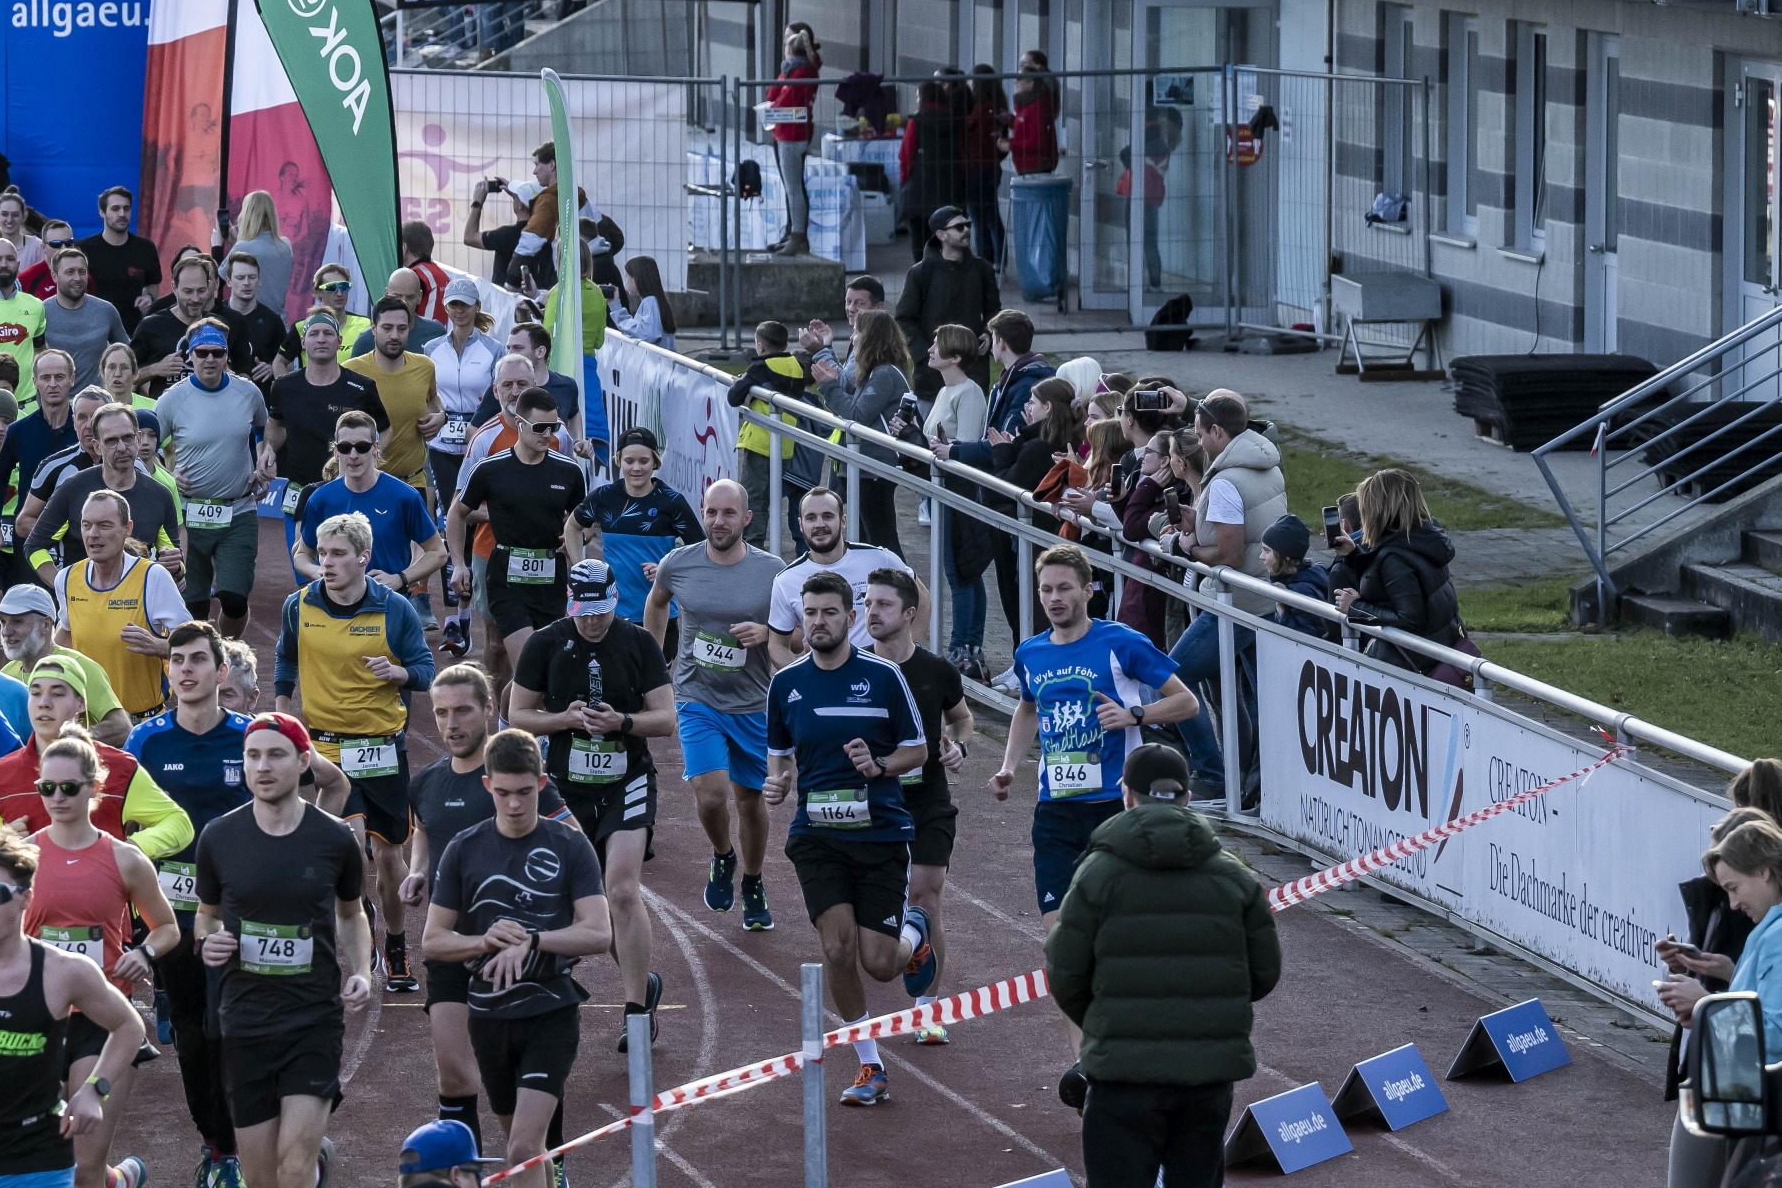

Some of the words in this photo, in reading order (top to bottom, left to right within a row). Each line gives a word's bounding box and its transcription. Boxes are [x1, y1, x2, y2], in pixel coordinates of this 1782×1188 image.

[198, 506, 222, 518] 409
[521, 559, 544, 572] 801
[108, 598, 138, 607] DACHSER
[349, 625, 380, 633] DACHSER
[706, 643, 733, 661] 944
[1033, 672, 1054, 685] Wyk
[1056, 667, 1074, 676] auf
[1074, 666, 1098, 680] Föhr
[851, 682, 868, 691] wfv
[1298, 660, 1428, 820] CREATON
[357, 747, 381, 764] 271
[584, 753, 612, 769] 102
[163, 763, 184, 771] JAKO
[1054, 765, 1087, 782] 846
[820, 806, 856, 820] 1164
[172, 876, 194, 895] 49
[1490, 842, 1508, 897] Die
[1511, 852, 1576, 929] Dachmarke
[1579, 882, 1598, 940] der
[1601, 907, 1657, 969] creativen
[258, 939, 295, 956] 748
[1506, 1024, 1549, 1055] allgaeu.de
[1382, 1070, 1426, 1102] allgaeu.de
[1277, 1111, 1328, 1144] allgaeu.de
